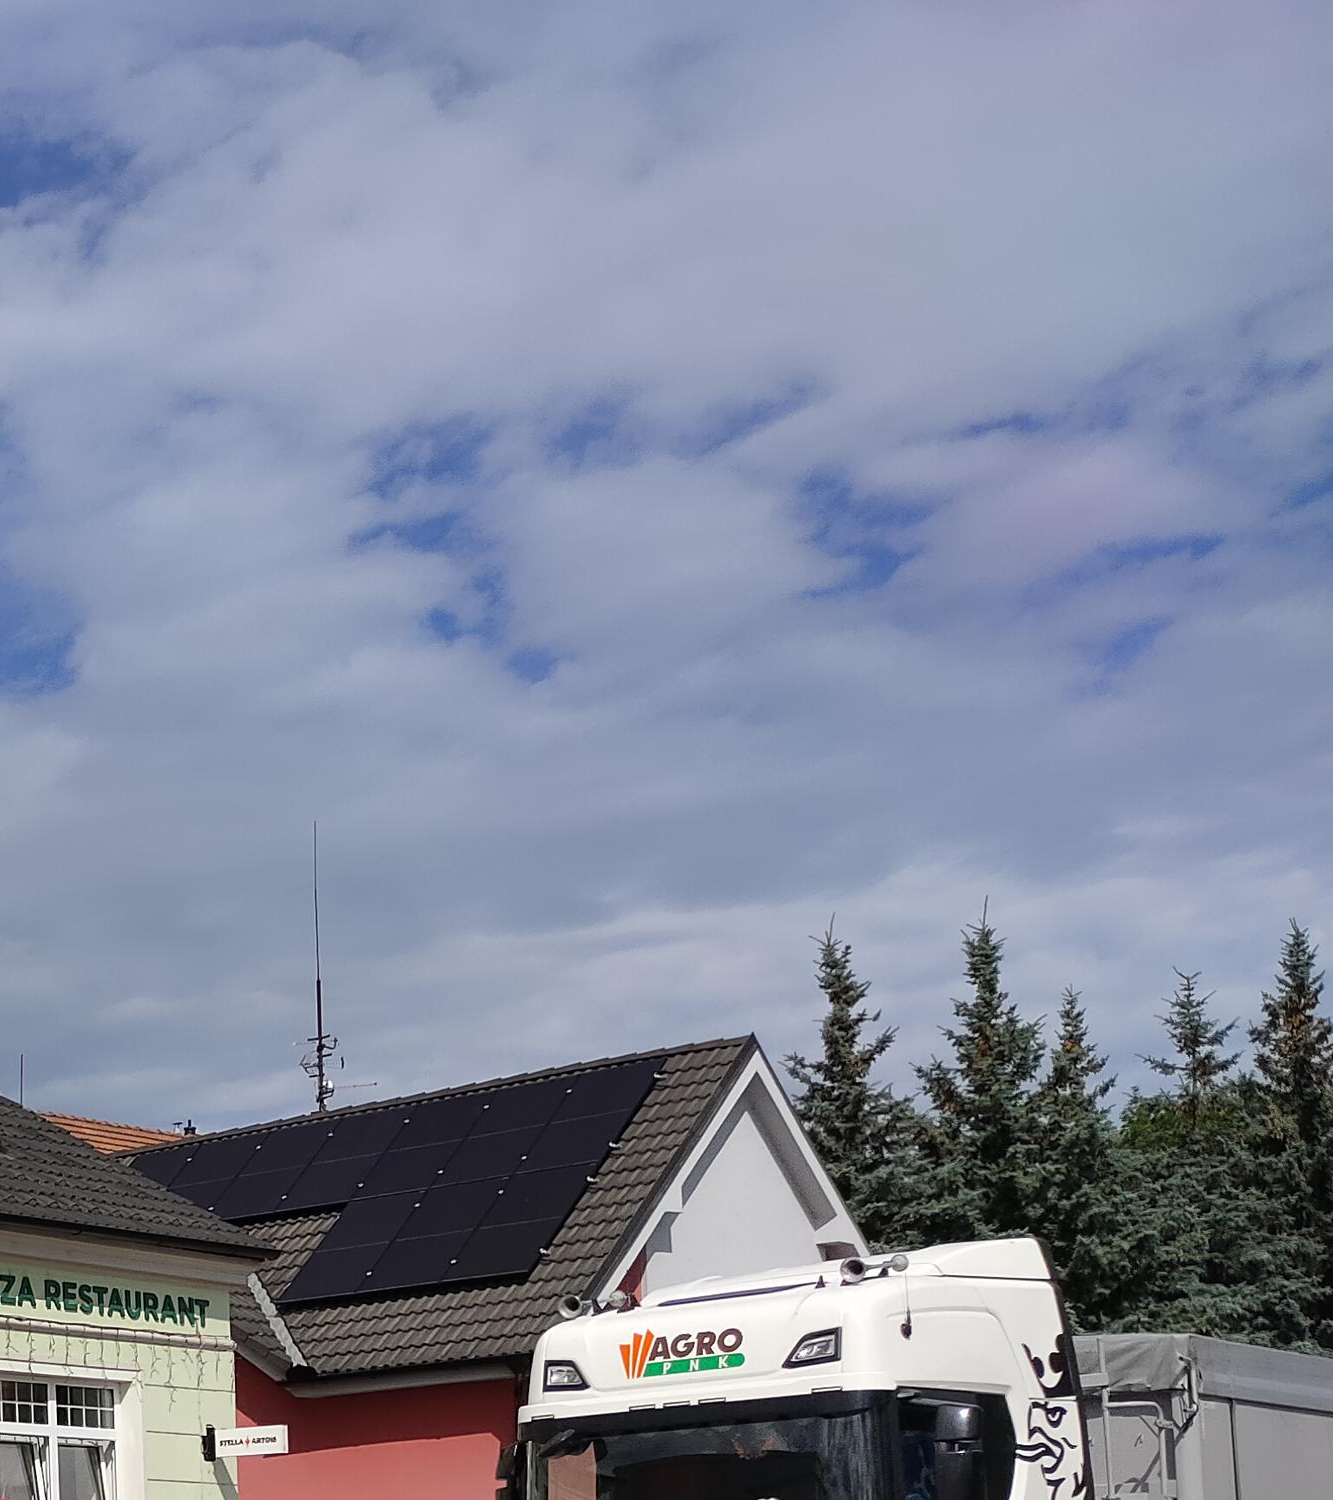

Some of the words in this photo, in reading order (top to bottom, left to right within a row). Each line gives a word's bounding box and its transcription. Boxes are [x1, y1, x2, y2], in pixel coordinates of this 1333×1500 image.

[44, 1279, 210, 1328] RESTAURANT
[649, 1328, 744, 1361] AGRO
[219, 1438, 244, 1447] STELLA
[251, 1436, 278, 1444] ARTOIS
